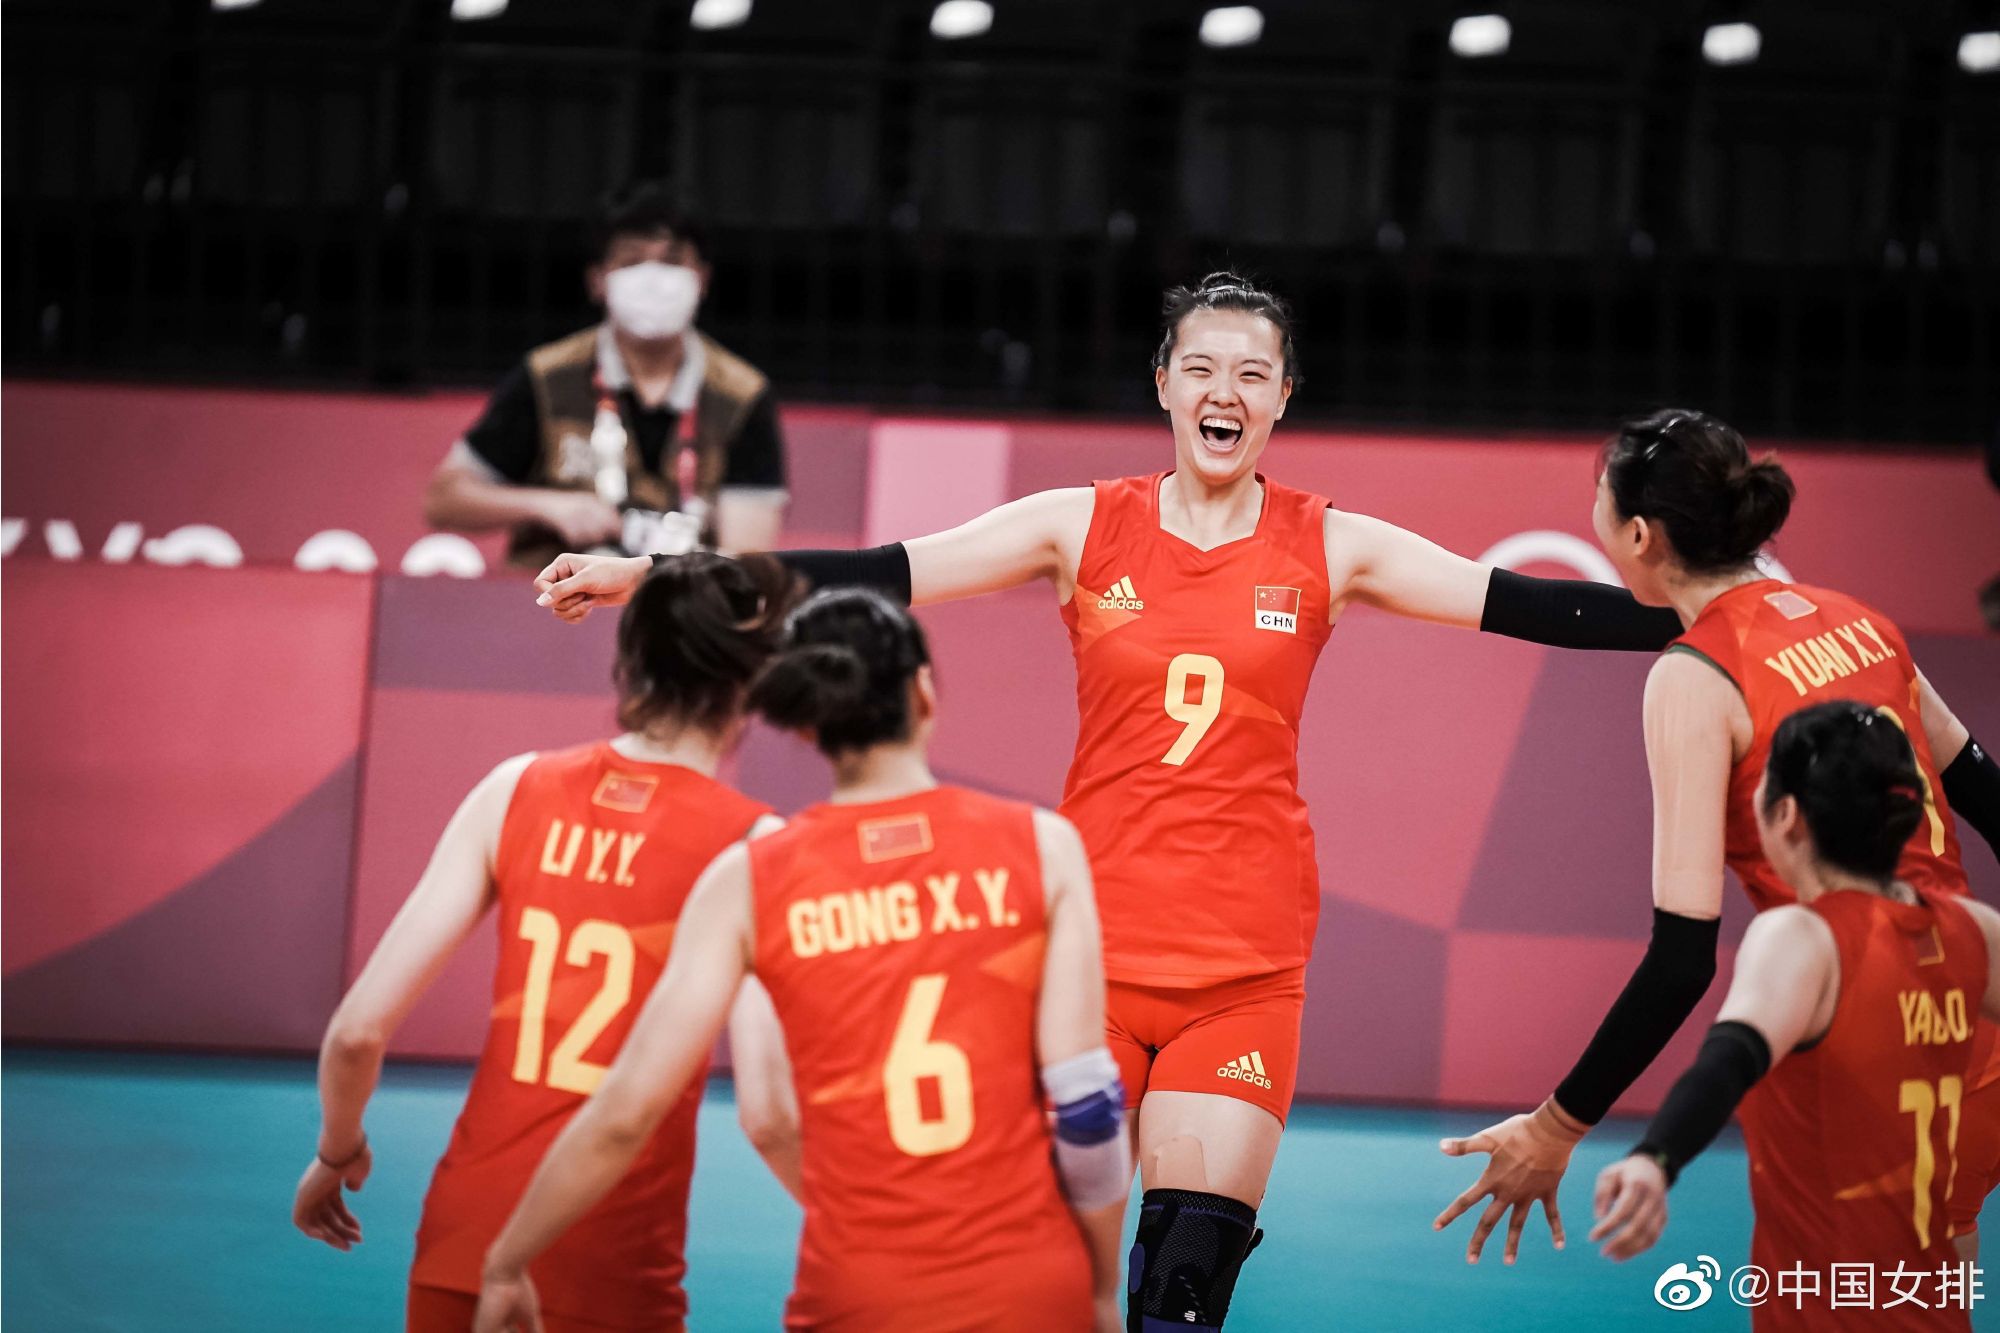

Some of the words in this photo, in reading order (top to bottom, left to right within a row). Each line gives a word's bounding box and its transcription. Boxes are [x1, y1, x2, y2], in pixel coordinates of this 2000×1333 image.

[1098, 596, 1144, 610] adidas
[1261, 615, 1293, 628] CHN
[1765, 632, 1859, 697] YUAN
[1160, 653, 1225, 766] 9
[540, 818, 586, 877] LI
[787, 881, 922, 958] GONG
[511, 906, 636, 1095] 12
[884, 974, 974, 1157] 6
[1217, 1065, 1272, 1090] adidas
